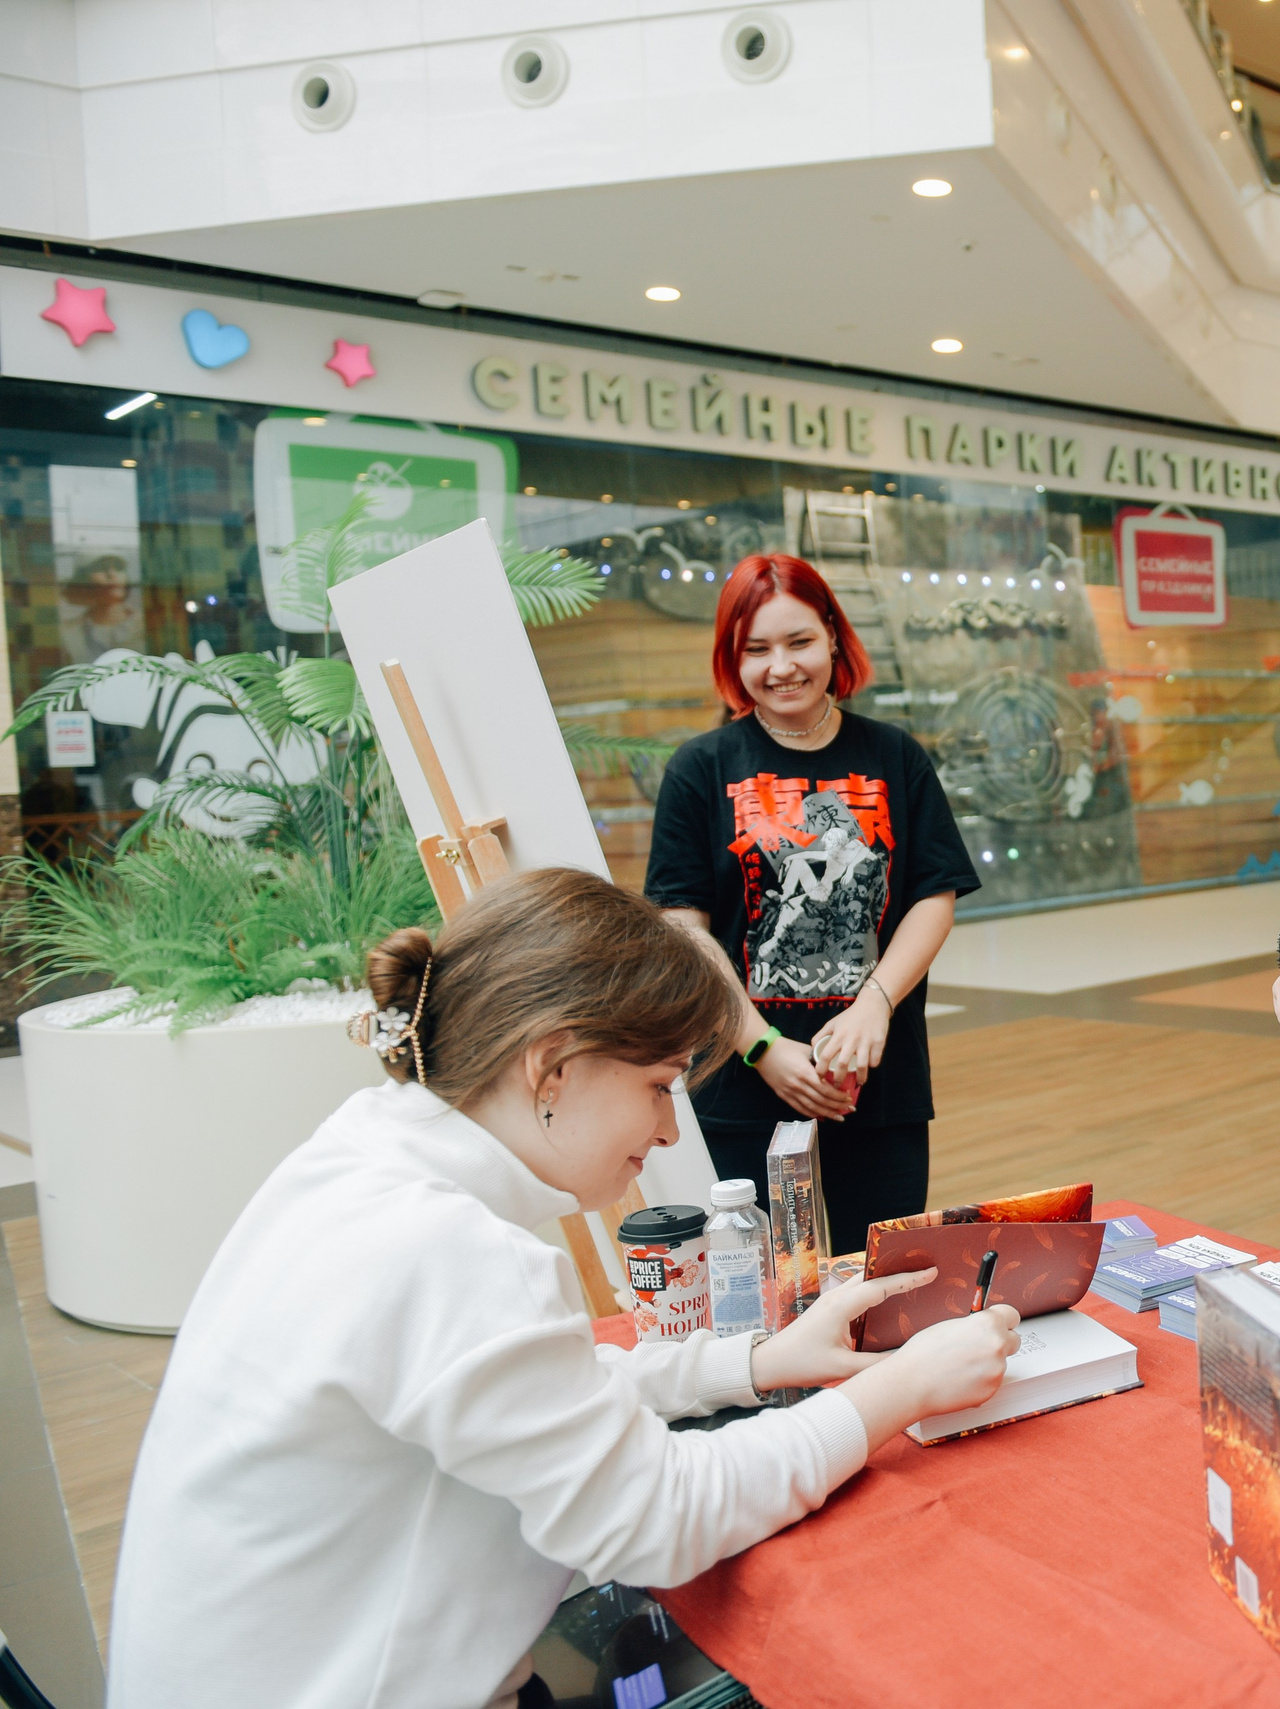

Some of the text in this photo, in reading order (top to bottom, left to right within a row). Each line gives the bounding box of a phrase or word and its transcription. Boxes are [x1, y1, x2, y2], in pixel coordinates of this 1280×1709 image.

[471, 355, 877, 458] СЕМЕЙНЫЕ
[905, 415, 1083, 479] ПАРКИ
[633, 1261, 662, 1275] PRICE
[631, 1274, 663, 1289] COFFEE
[660, 1312, 707, 1337] HOLID
